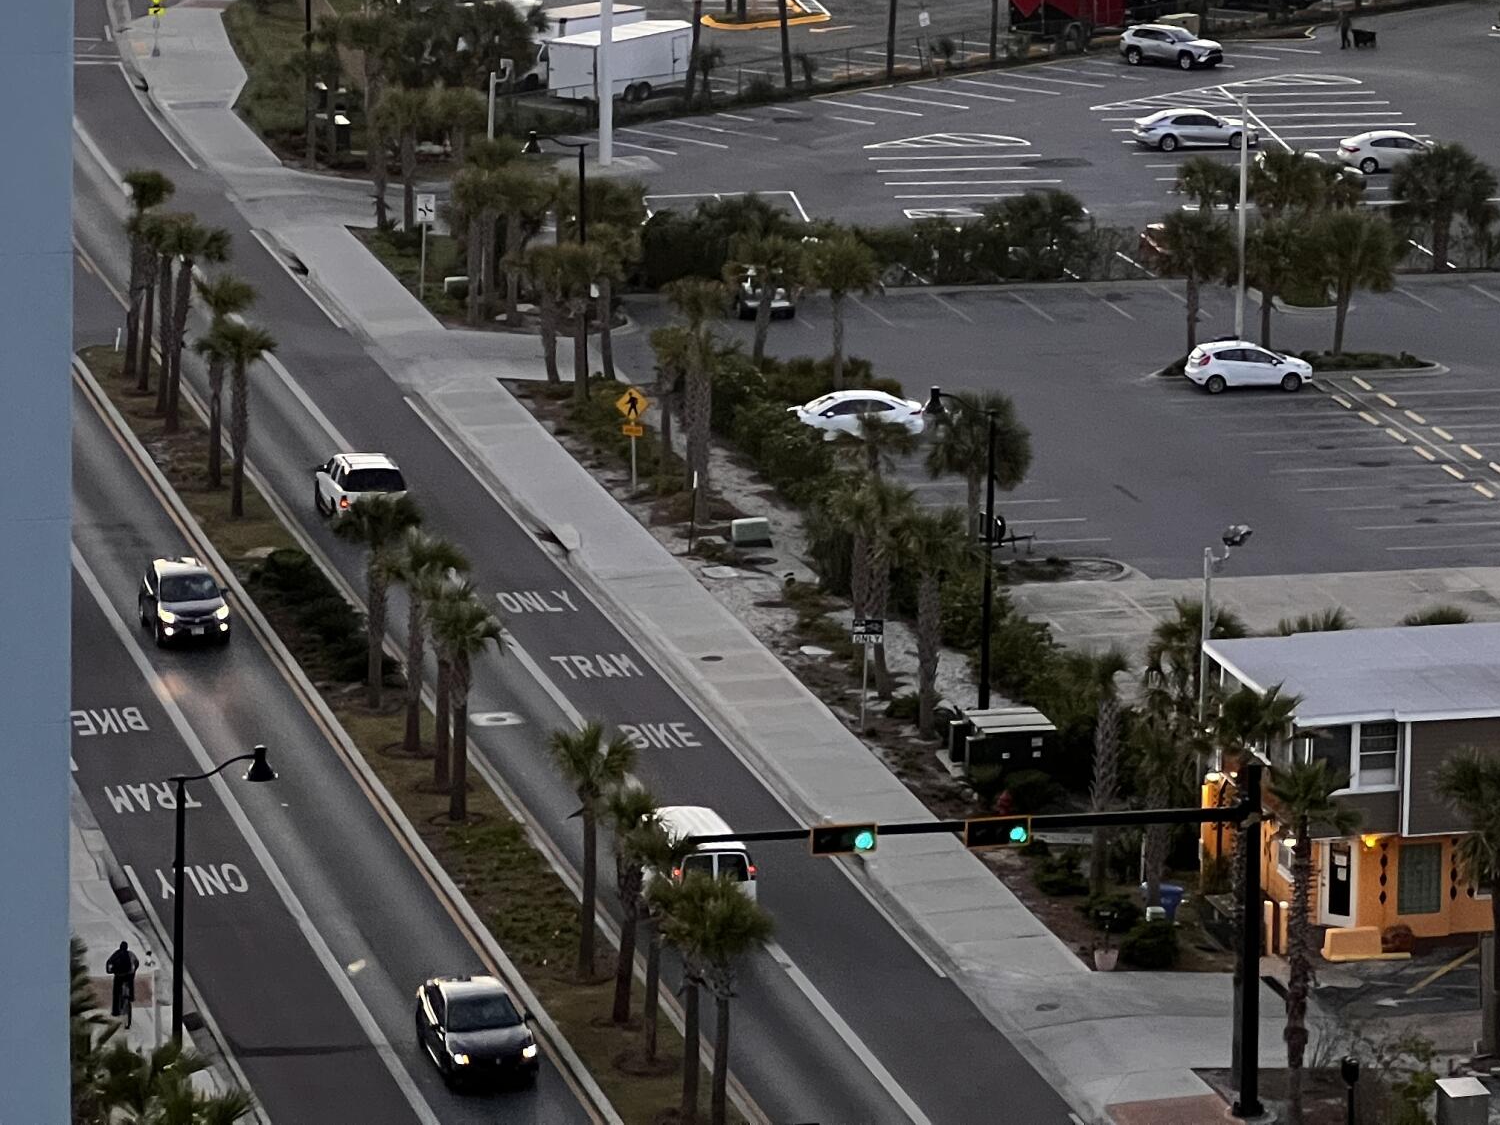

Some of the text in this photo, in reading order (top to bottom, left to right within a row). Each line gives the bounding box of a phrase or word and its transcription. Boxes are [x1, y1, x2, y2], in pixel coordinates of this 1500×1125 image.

[496, 590, 578, 612] ONLY
[550, 653, 644, 679] TRAM
[71, 707, 150, 736] BIKE
[617, 723, 702, 748] BIKE
[104, 781, 203, 813] TRAM
